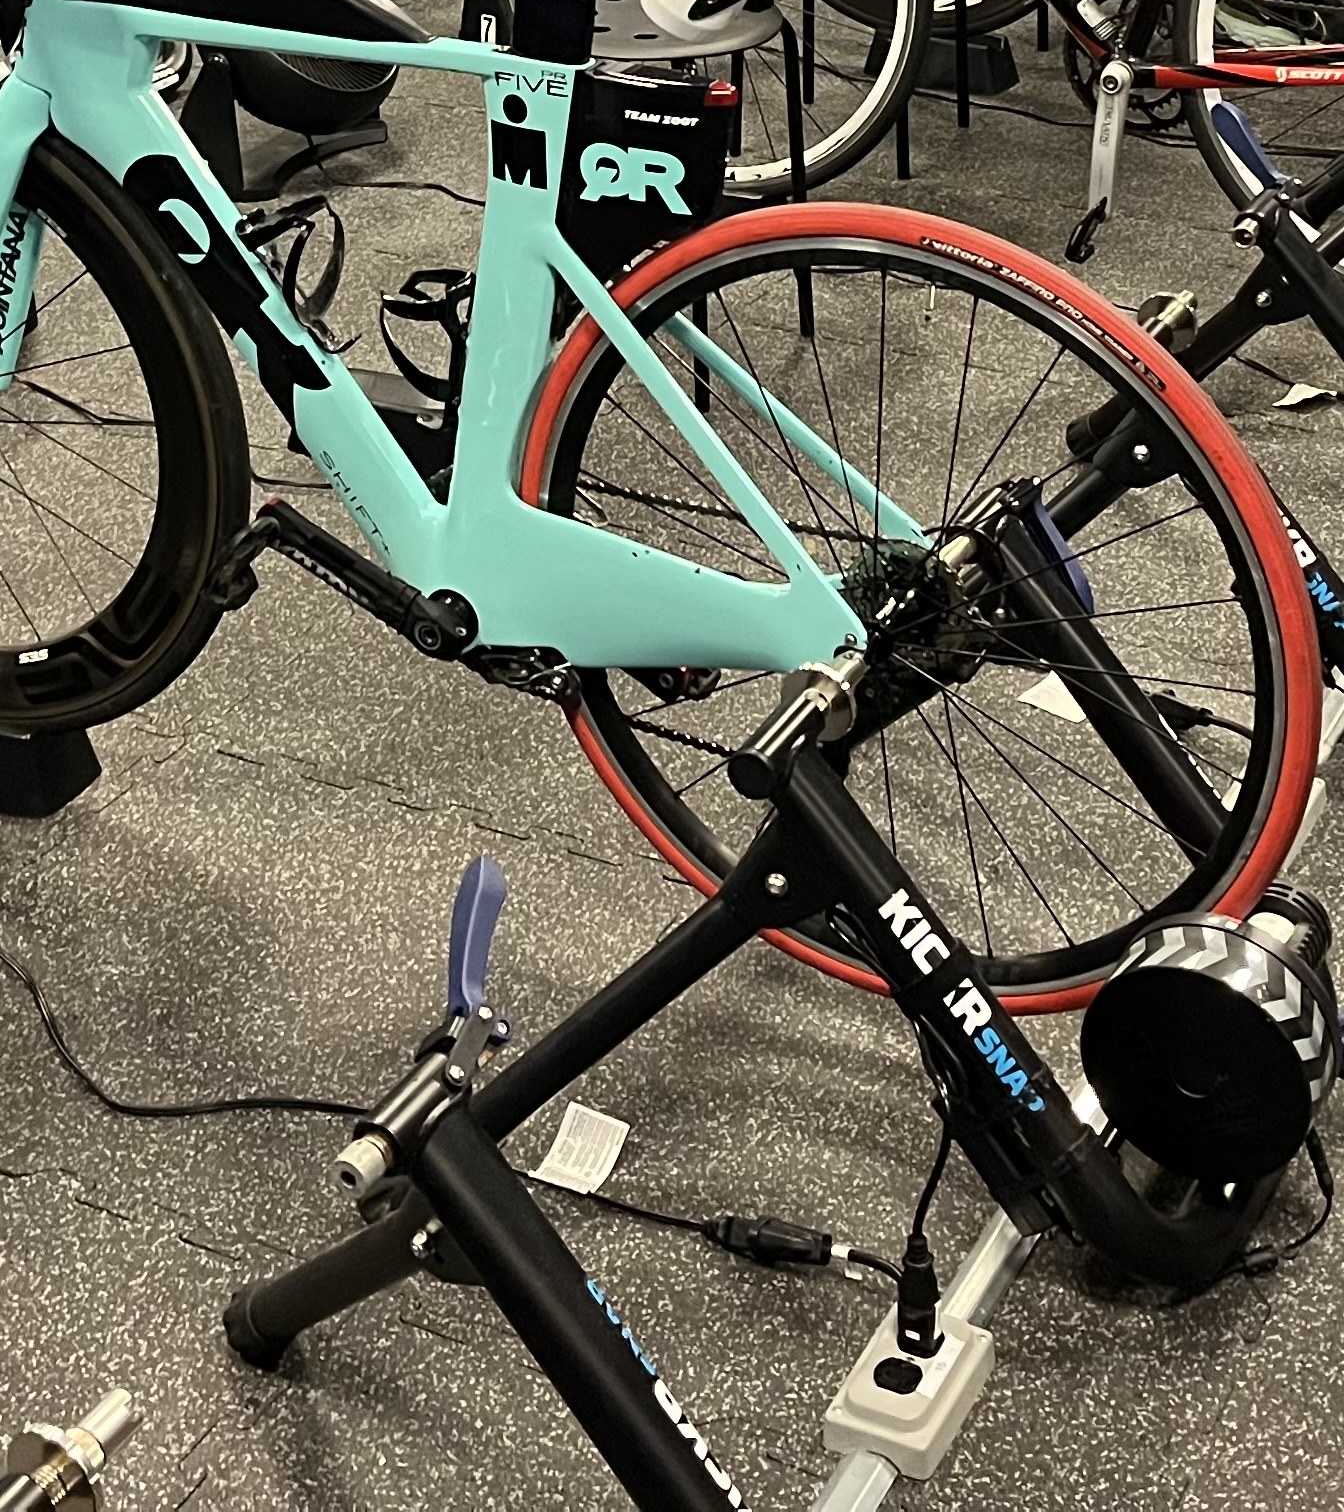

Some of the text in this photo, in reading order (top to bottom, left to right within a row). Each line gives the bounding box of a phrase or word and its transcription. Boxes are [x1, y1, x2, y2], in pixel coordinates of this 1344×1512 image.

[494, 71, 569, 98] FIVE
[624, 109, 700, 127] TEAM ZOOT
[579, 142, 694, 216] QR
